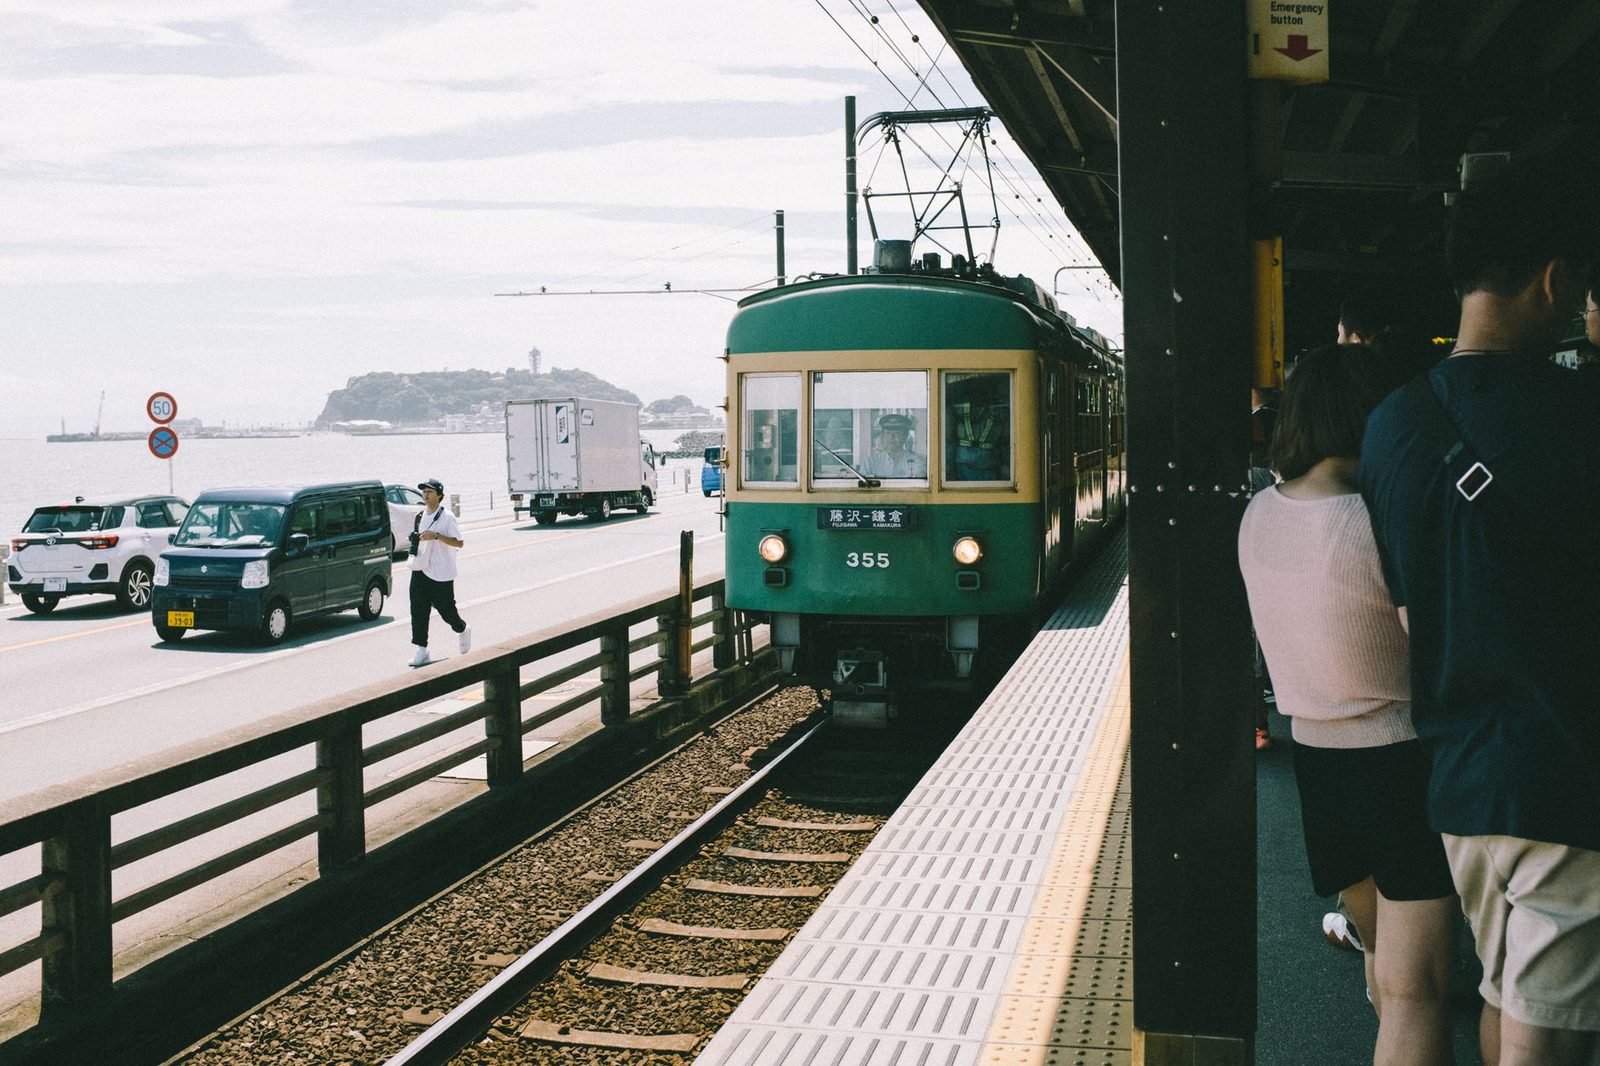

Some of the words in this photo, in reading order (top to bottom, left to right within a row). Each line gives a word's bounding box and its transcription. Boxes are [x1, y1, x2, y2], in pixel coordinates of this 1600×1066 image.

[1271, 1, 1324, 15] Emergency
[1271, 14, 1303, 25] button
[153, 401, 171, 416] 50
[846, 552, 890, 568] 355
